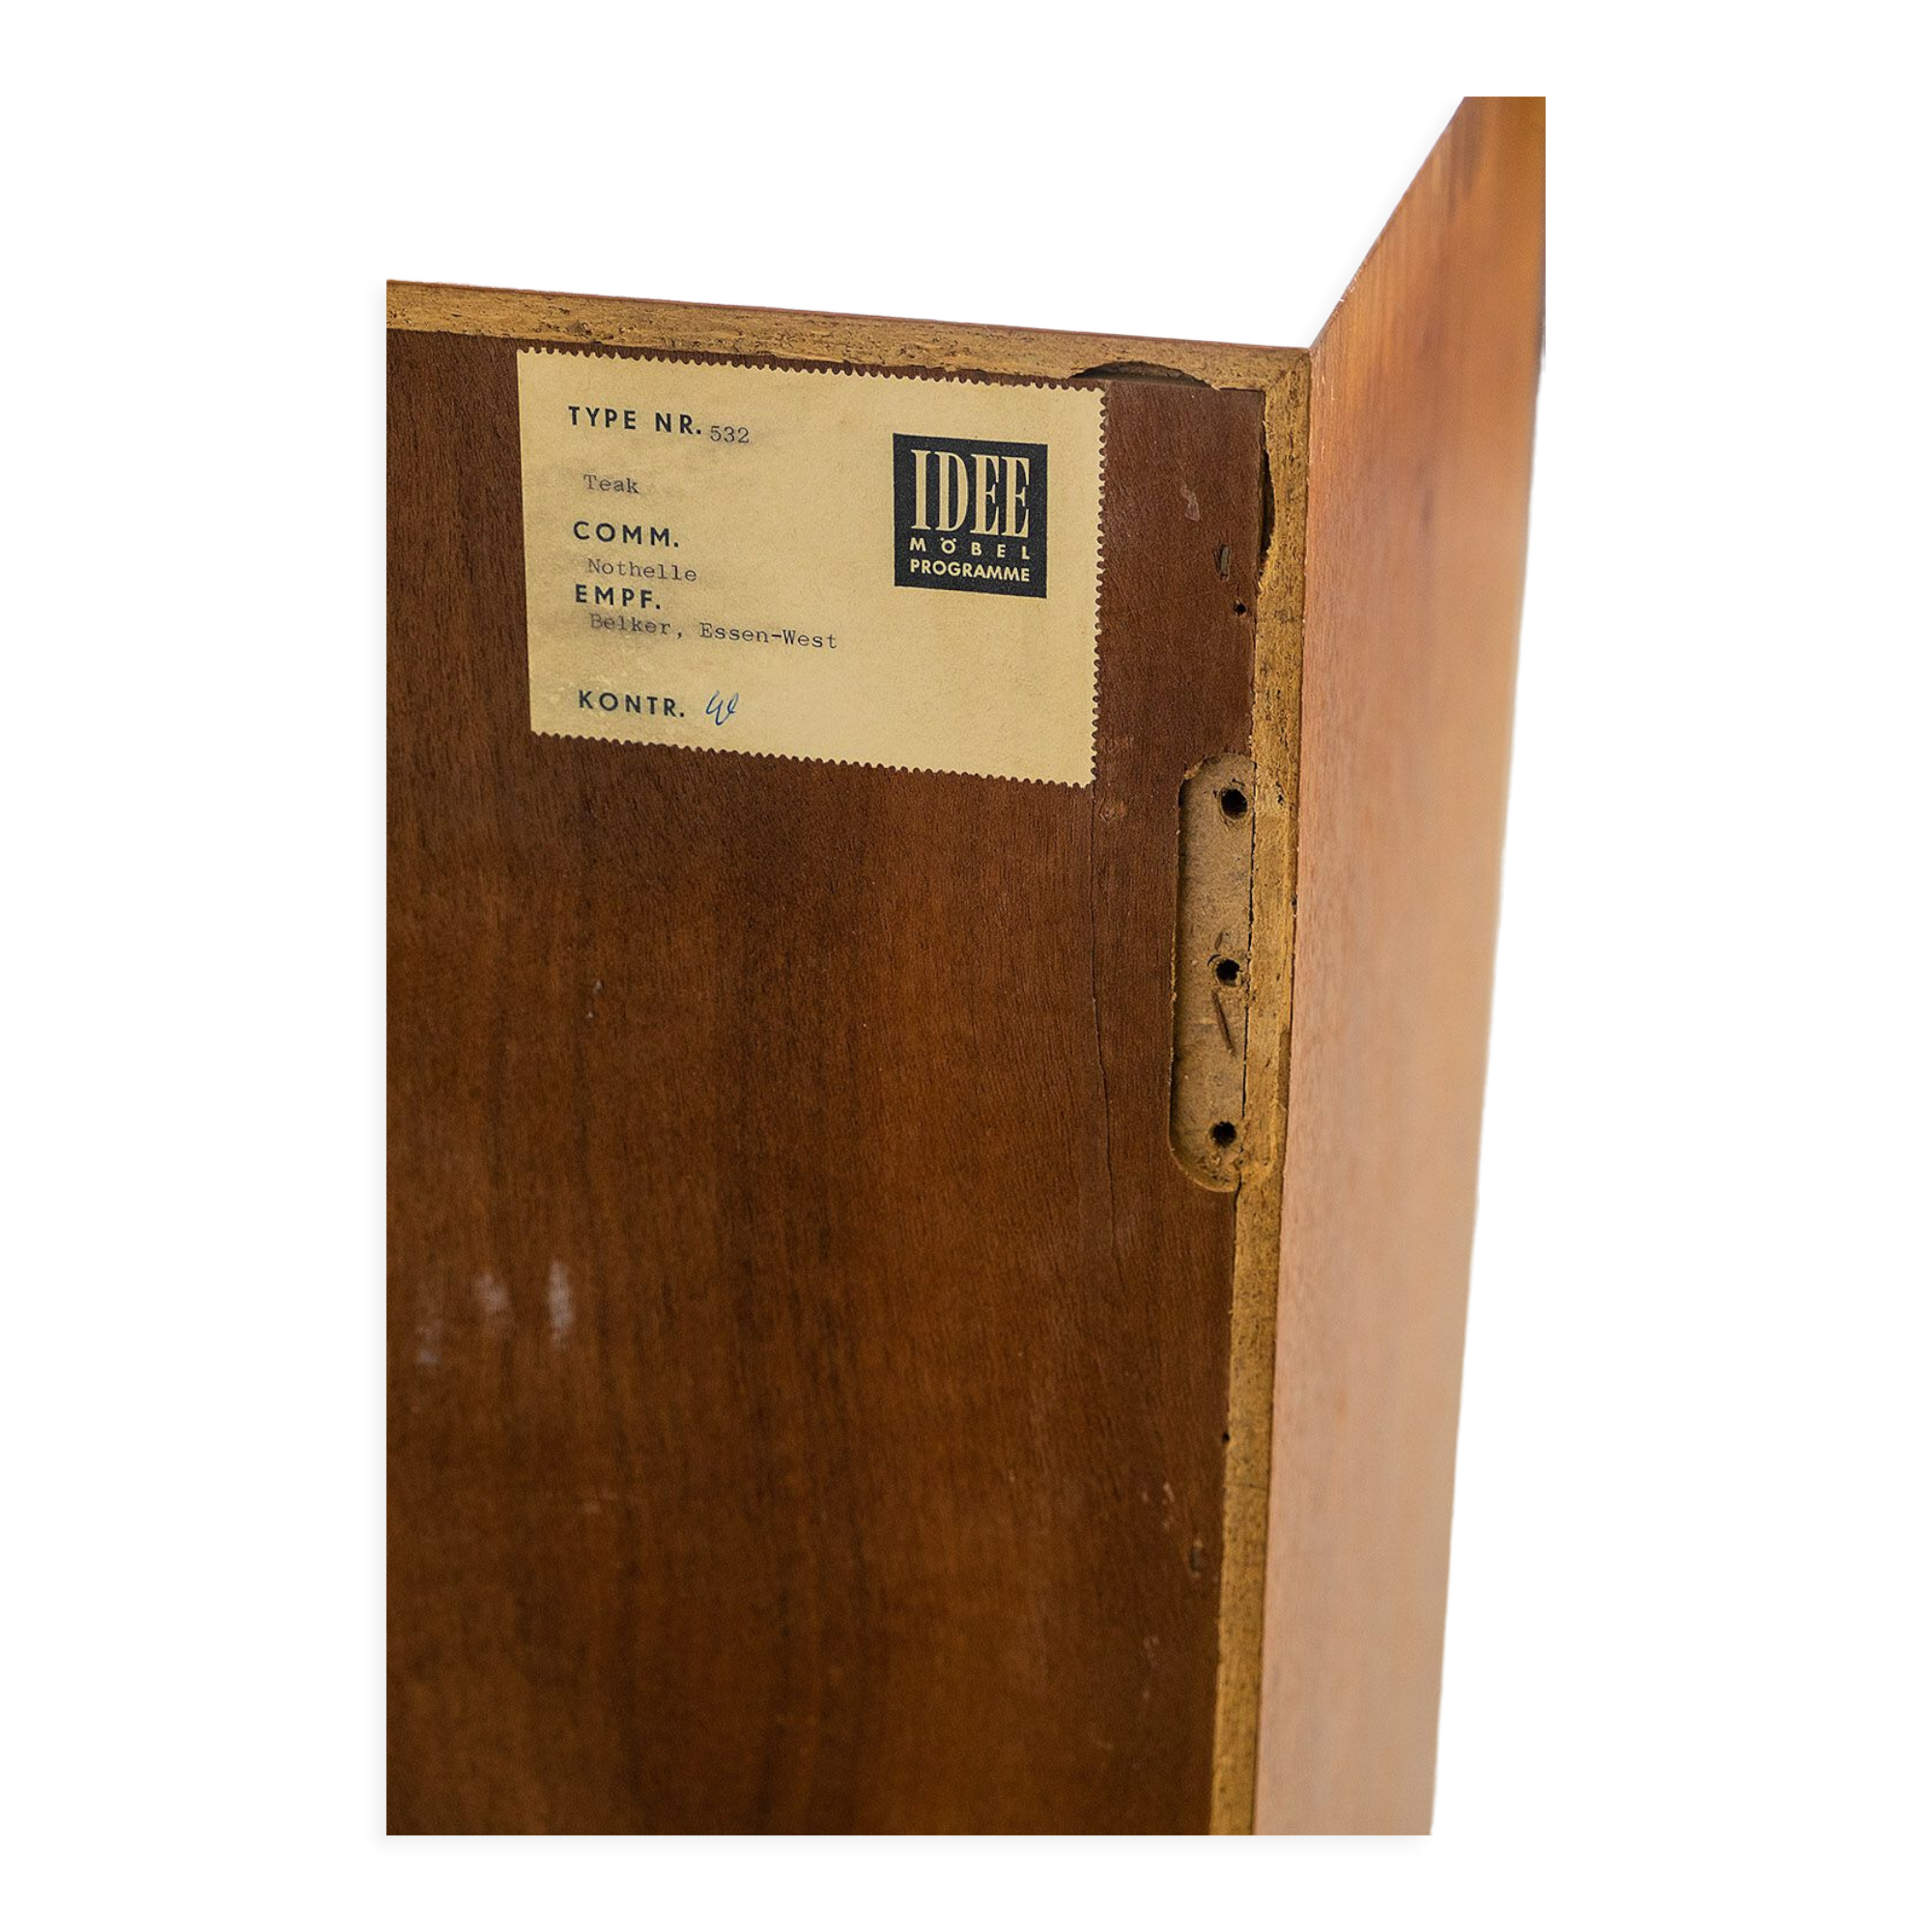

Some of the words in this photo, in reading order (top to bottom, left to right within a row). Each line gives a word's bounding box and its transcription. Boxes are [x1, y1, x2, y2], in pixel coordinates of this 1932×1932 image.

[569, 406, 637, 431] TYPE
[655, 412, 702, 435] NR.
[710, 425, 751, 444] 532
[583, 473, 639, 495] Teak
[910, 449, 1030, 538] IDEE
[573, 521, 680, 548] COMM.
[910, 536, 1031, 560] MÖBEL
[587, 558, 697, 582] Nothelle
[910, 558, 1030, 582] PROGRAMME
[575, 583, 661, 610] EMPF.
[590, 612, 684, 639] Belker,
[699, 622, 838, 649] Essen-West
[579, 690, 685, 718] KONTR.
